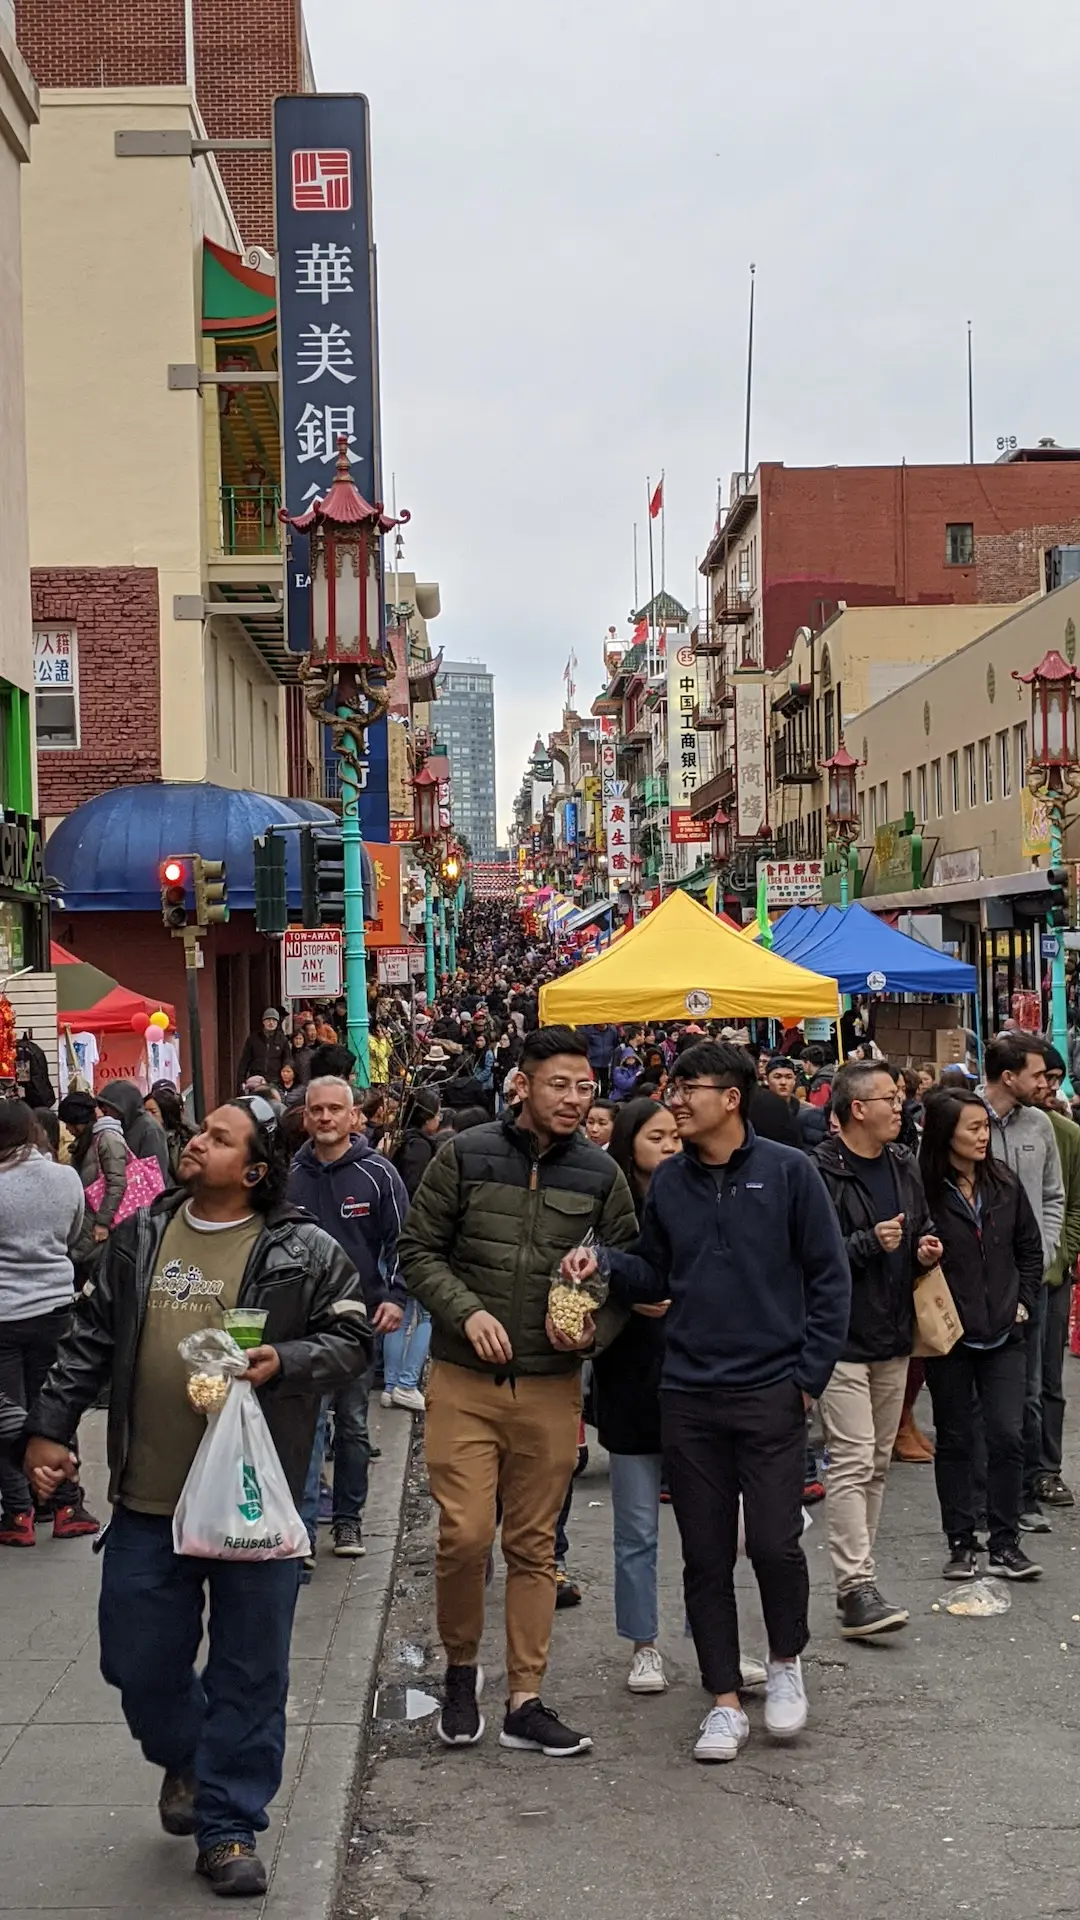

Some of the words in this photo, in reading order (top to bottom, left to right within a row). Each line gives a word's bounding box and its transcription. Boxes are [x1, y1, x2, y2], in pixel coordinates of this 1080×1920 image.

[295, 242, 364, 516] 華美銀
[33, 659, 70, 682] 公證
[679, 676, 698, 788] 中国工商银行
[289, 932, 336, 940] TOW-AWAY
[286, 942, 301, 957] NO
[303, 944, 338, 956] STOPPING
[302, 959, 324, 970] ANY
[301, 971, 326, 983] TIME
[149, 1275, 190, 1293] EACH
[190, 1279, 225, 1295] BUM
